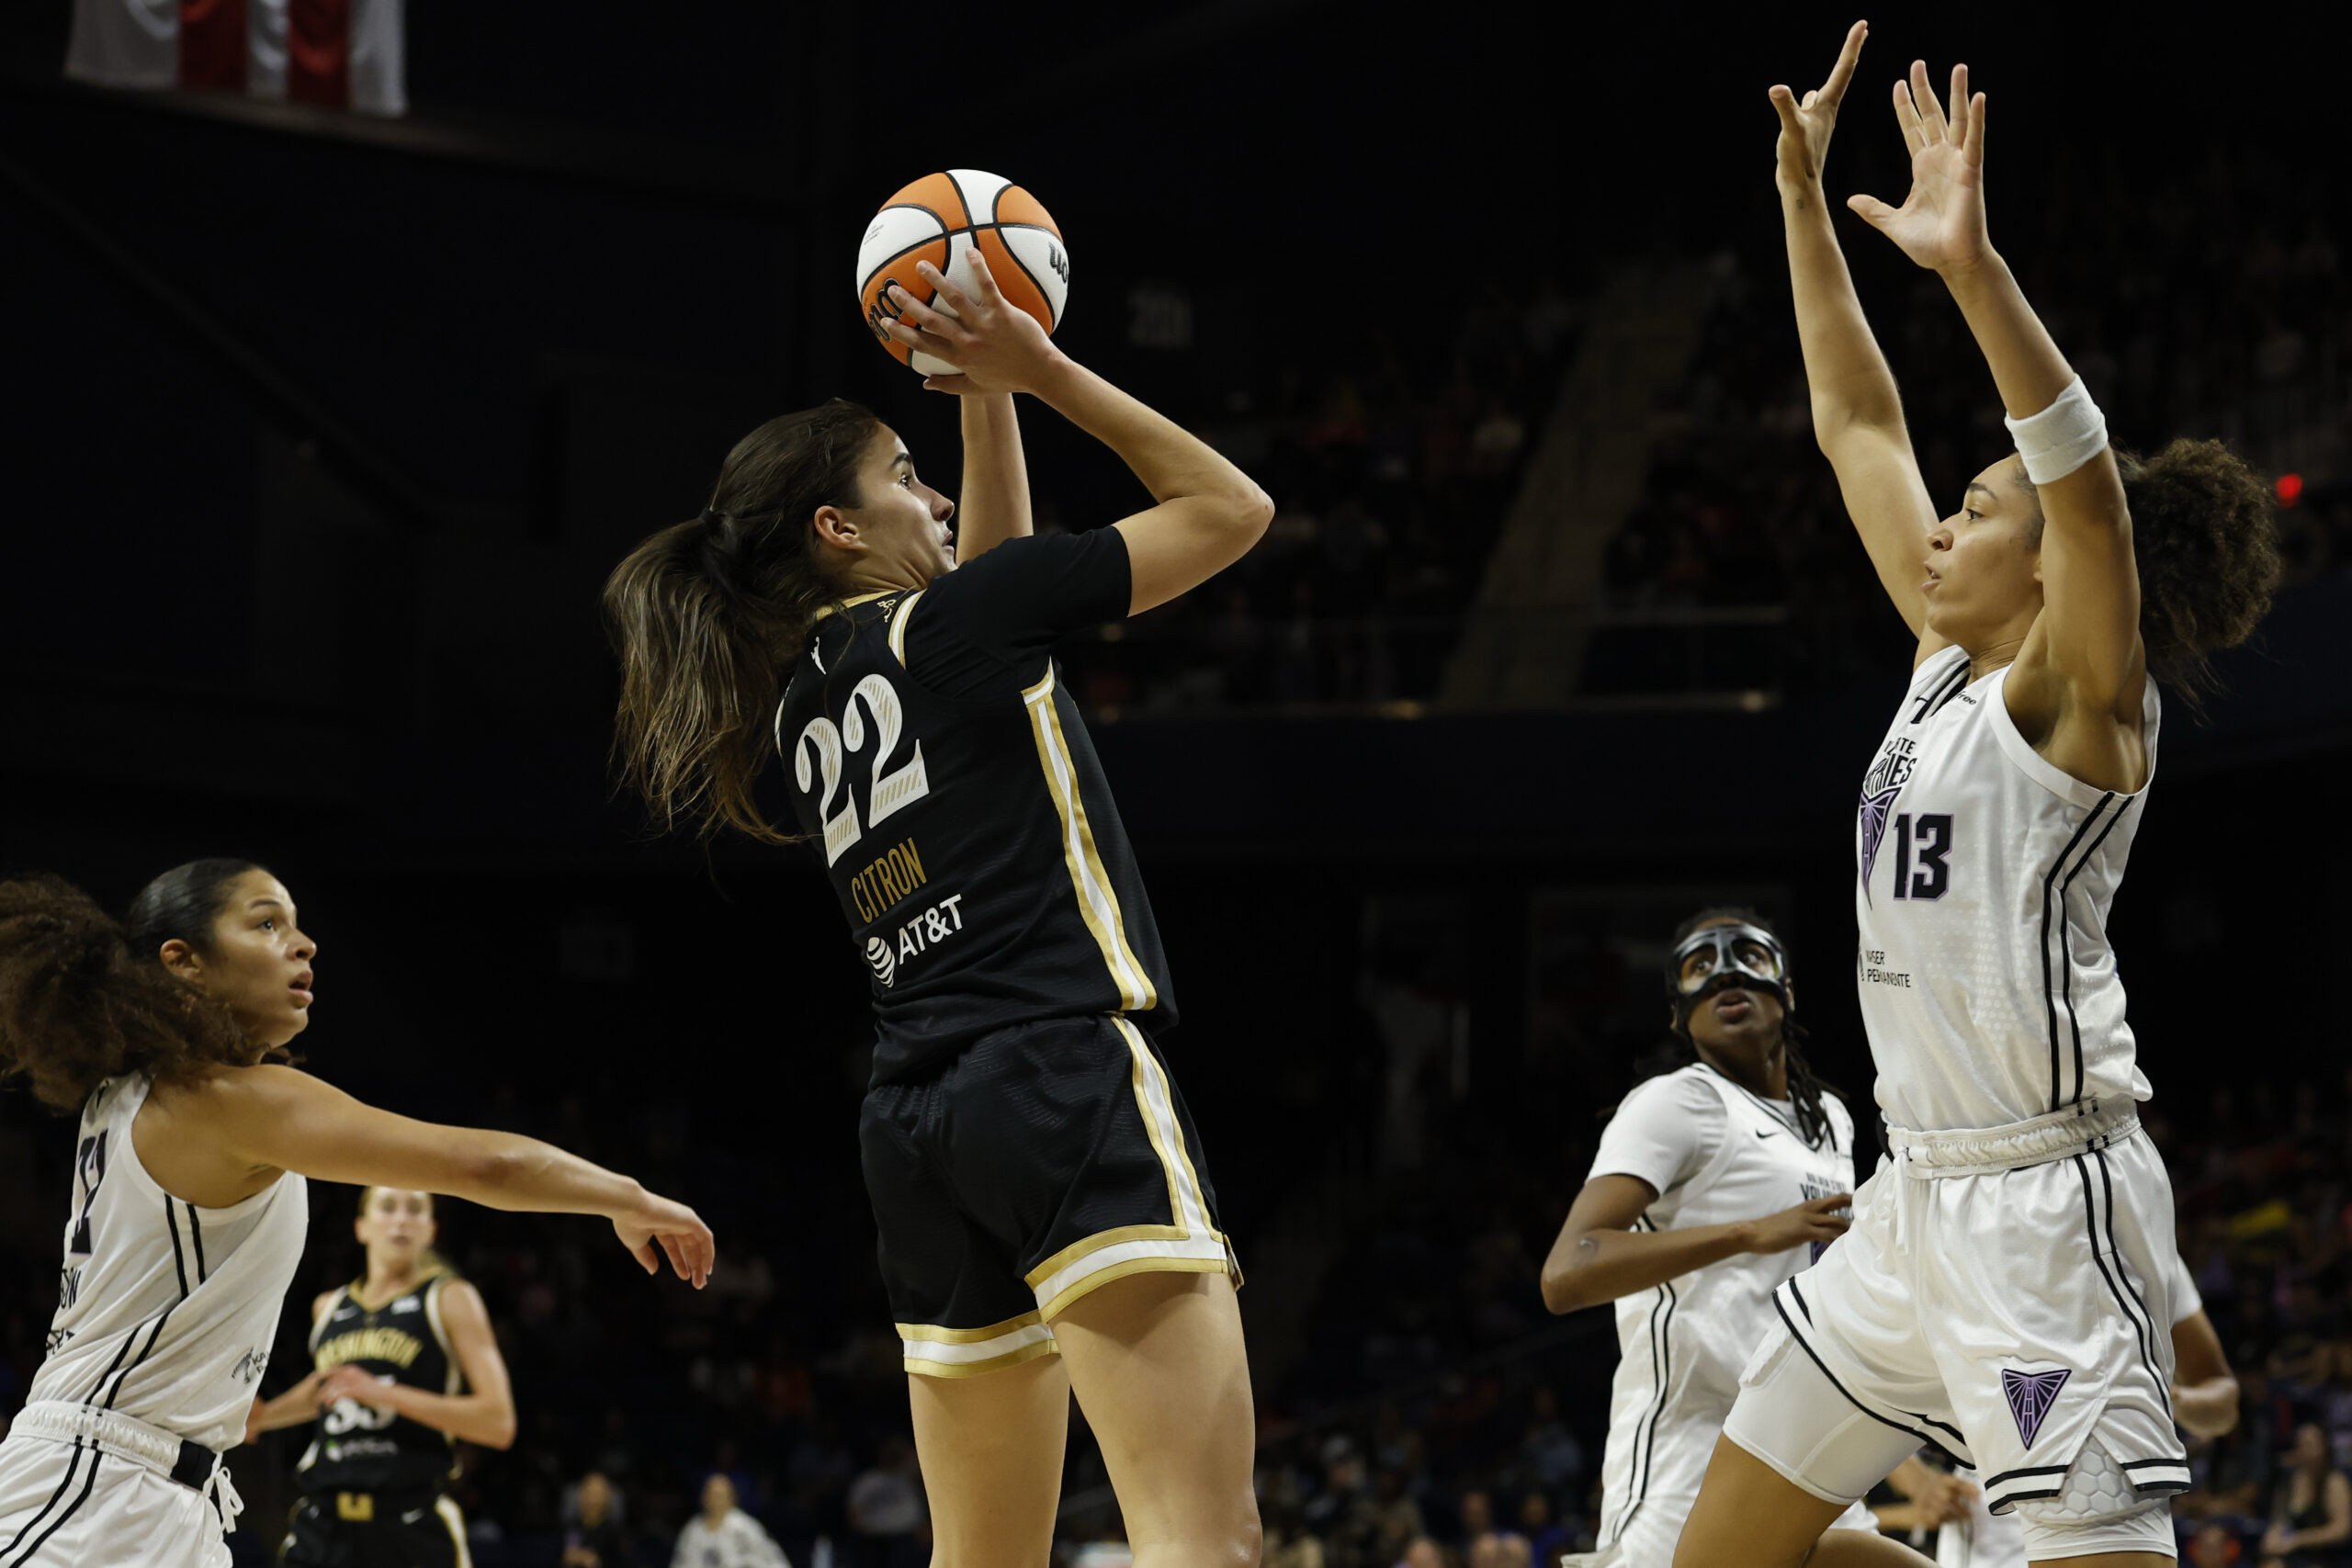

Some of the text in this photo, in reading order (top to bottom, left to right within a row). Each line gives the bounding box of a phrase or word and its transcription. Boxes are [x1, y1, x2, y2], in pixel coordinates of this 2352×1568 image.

[796, 673, 930, 868] 22
[852, 837, 927, 923] CITRON
[1893, 813, 1954, 901] 13
[899, 894, 963, 965] AT&T
